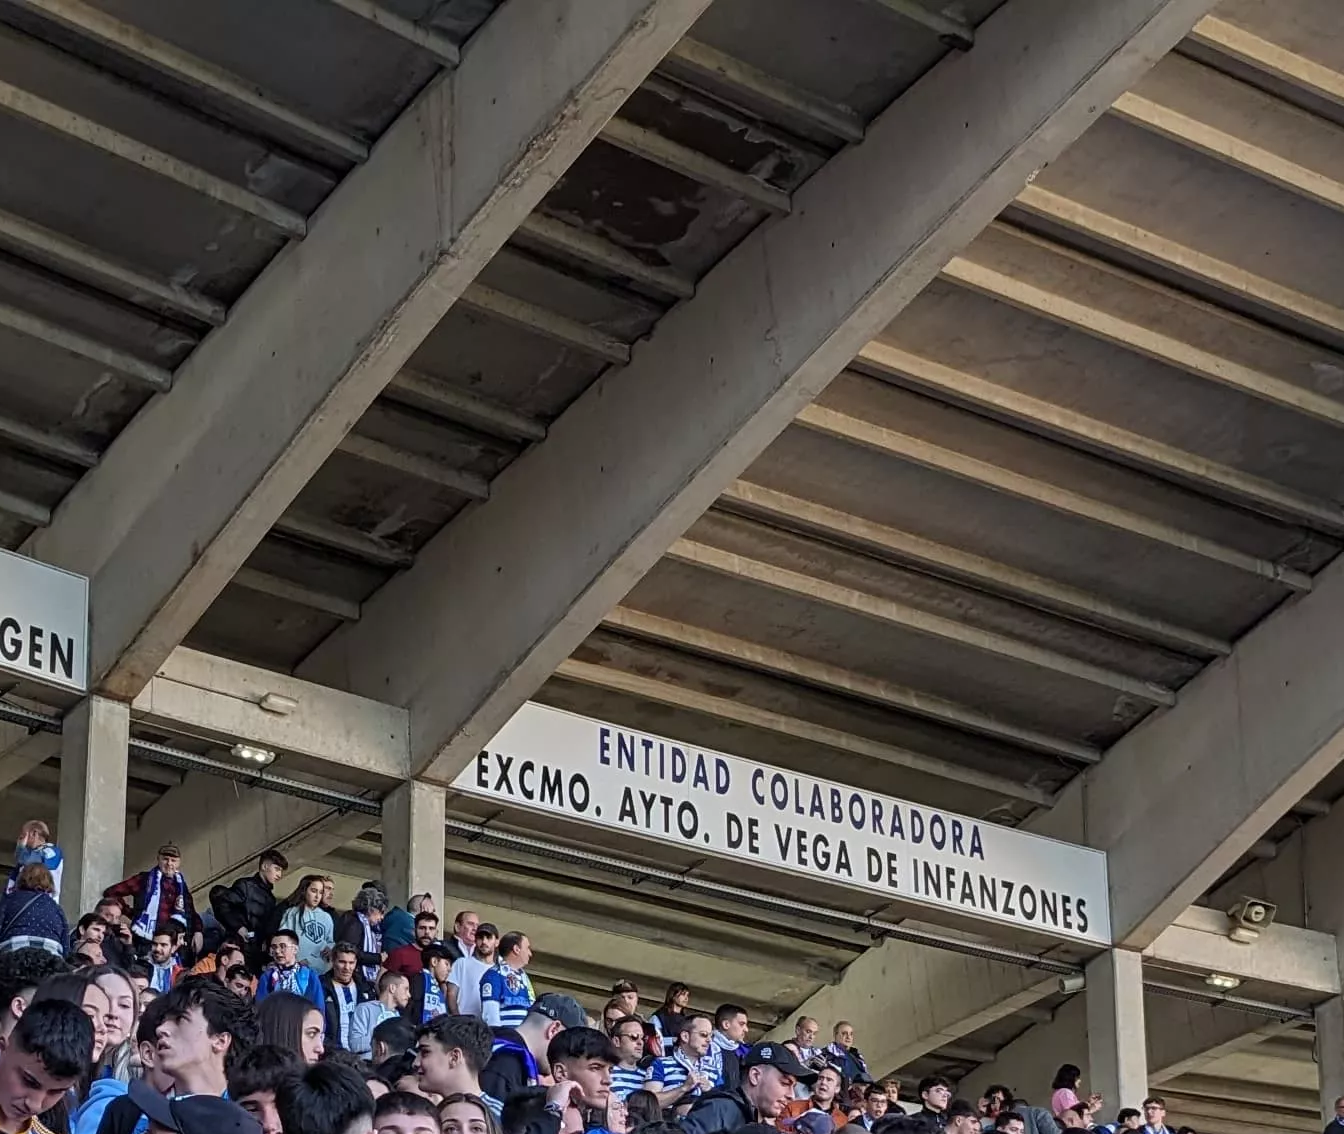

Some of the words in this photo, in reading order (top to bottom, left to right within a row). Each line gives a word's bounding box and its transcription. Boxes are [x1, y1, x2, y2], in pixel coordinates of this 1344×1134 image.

[477, 750, 601, 818] EXCMO.
[619, 786, 710, 844] AYTO.
[726, 811, 760, 854] DE
[774, 824, 852, 878] VEGA
[867, 846, 899, 889] DE
[912, 858, 1089, 934] INFANZONES
[599, 727, 730, 795] ENTIDAD
[751, 766, 984, 861] COLABORADORA
